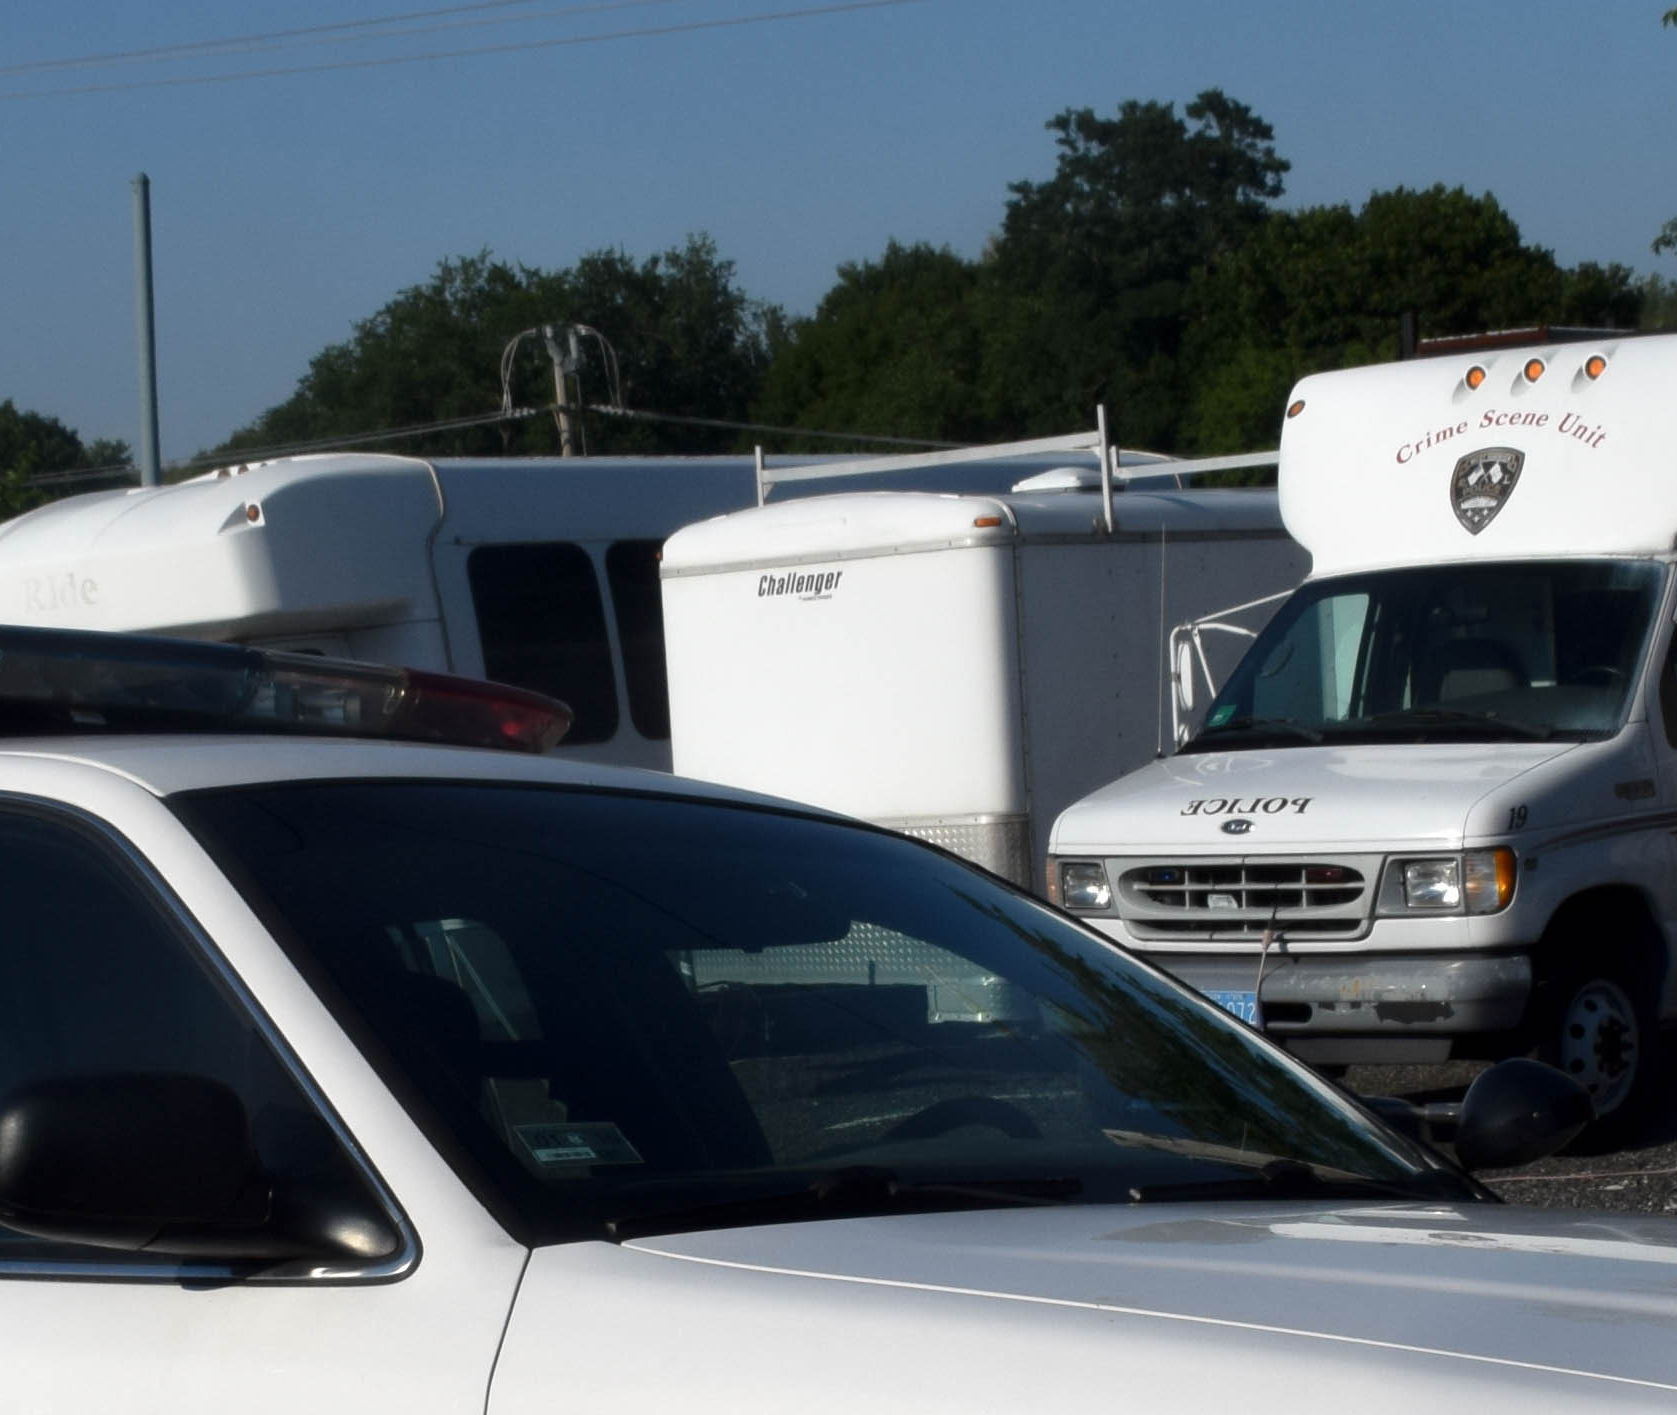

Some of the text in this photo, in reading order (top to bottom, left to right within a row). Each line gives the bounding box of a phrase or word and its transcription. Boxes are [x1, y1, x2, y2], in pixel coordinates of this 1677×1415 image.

[1396, 409, 1607, 464] Crime Scene Unit
[757, 571, 843, 597] Challenger
[1508, 805, 1528, 831] 19
